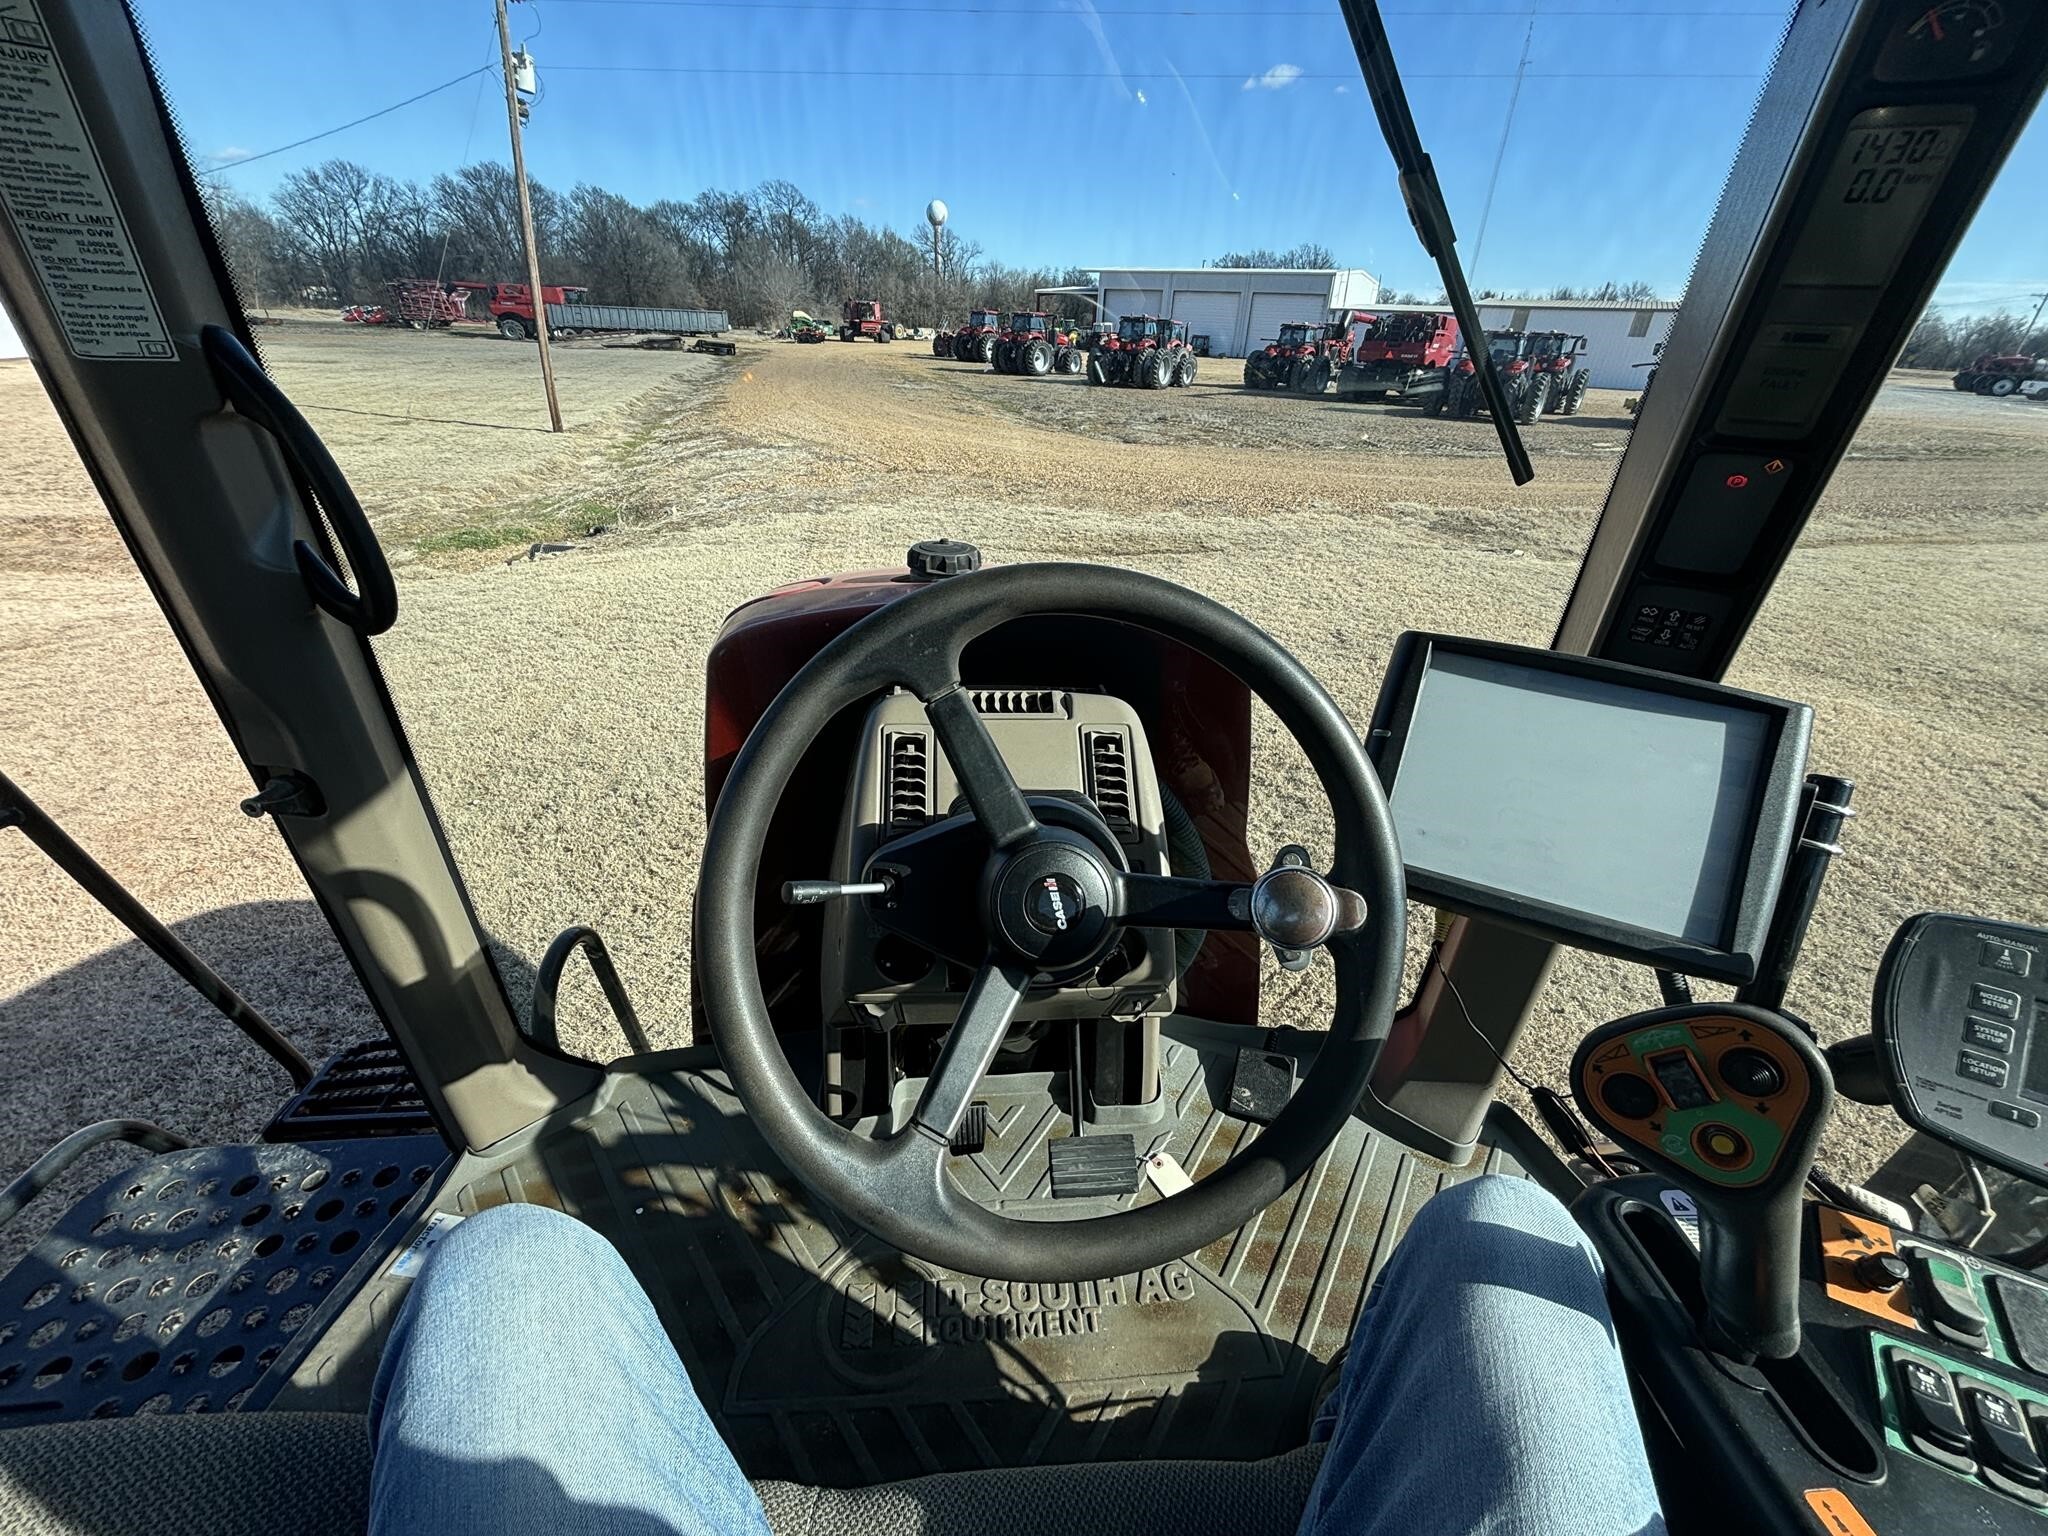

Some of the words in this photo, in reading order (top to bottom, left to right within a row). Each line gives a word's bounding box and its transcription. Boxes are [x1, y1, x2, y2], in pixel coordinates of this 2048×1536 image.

[13, 207, 70, 221] WEIGHT
[75, 213, 115, 226] LIMIT
[26, 222, 84, 236] Maximum
[87, 228, 114, 238] GVW
[40, 254, 55, 263] DO
[57, 257, 78, 265] NOT
[81, 258, 125, 267] Transport
[69, 283, 89, 291] NOT
[61, 311, 96, 320] Failure
[99, 312, 110, 320] to
[112, 314, 149, 323] comply
[65, 320, 93, 328] could
[96, 321, 125, 329] result
[69, 328, 97, 336] death
[1049, 891, 1068, 930] CASE
[1979, 991, 2014, 1005] NOZZLE
[1981, 998, 2009, 1009] SETUP
[1974, 1024, 2008, 1039] SYSTEM
[1976, 1032, 2003, 1043] SETUP
[1962, 1057, 2005, 1074] LOCATION
[1969, 1065, 1997, 1077] SETUP
[2011, 1109, 2018, 1119] 1
[1135, 1263, 1195, 1304] AG
